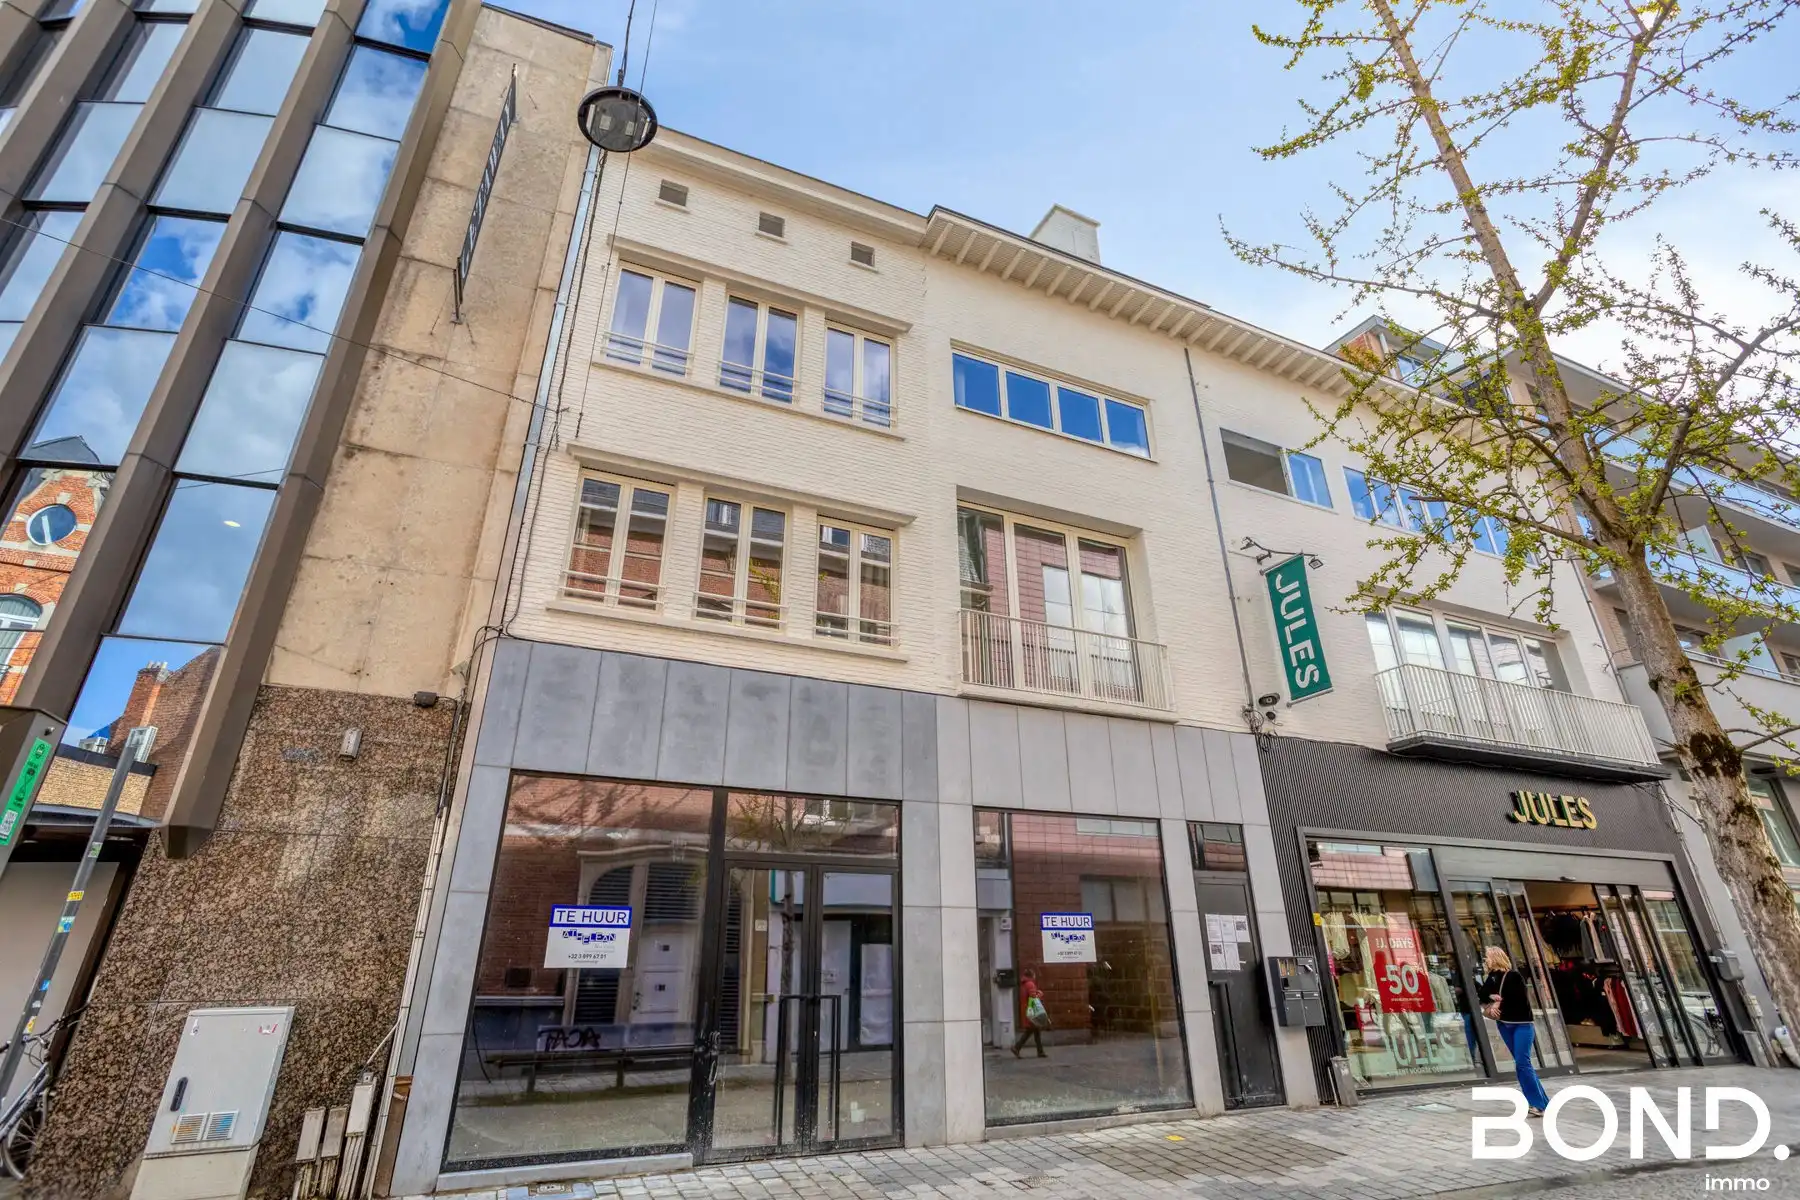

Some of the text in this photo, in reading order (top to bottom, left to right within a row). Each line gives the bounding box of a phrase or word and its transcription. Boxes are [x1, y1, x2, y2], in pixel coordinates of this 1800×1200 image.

[1276, 573, 1320, 688] JULES
[1511, 790, 1597, 829] JULES
[556, 910, 627, 924] TE HUUR
[1044, 916, 1090, 927] TE HUUR
